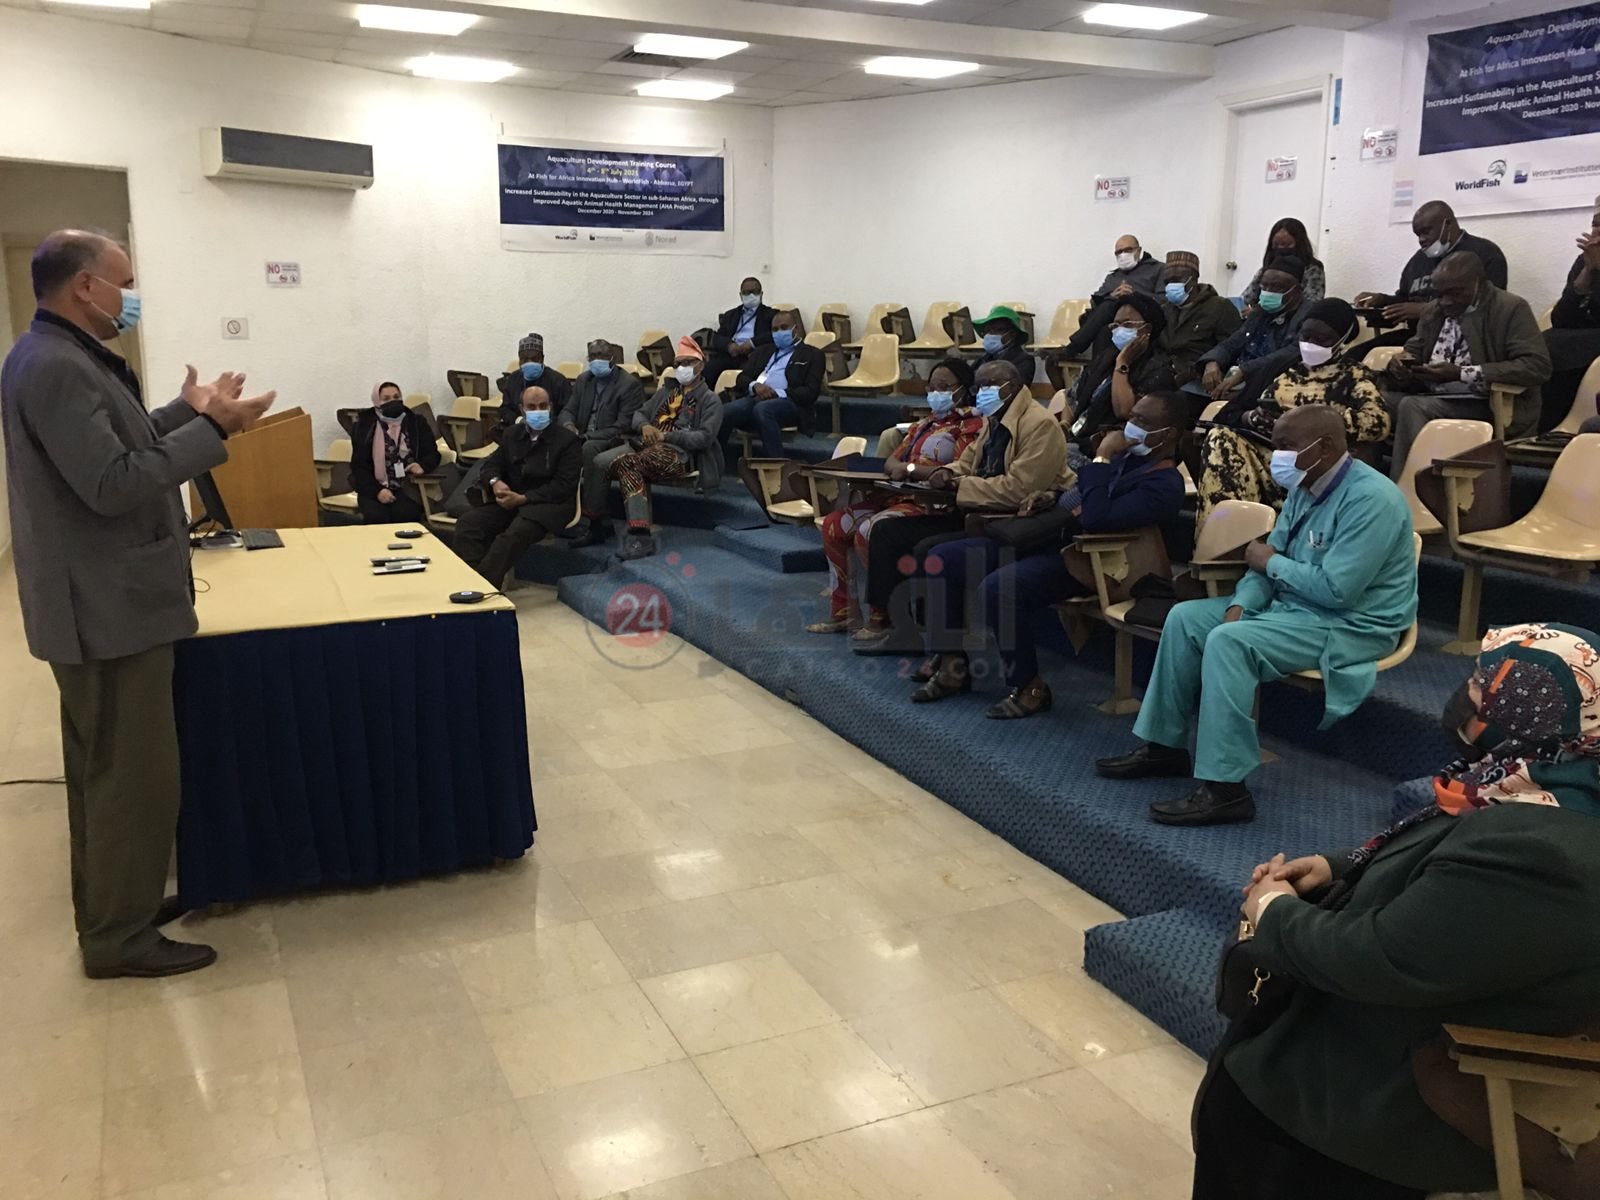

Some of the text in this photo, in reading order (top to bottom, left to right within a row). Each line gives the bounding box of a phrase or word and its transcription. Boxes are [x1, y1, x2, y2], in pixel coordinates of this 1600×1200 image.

[1485, 17, 1600, 45] Aquaculture Developm
[1459, 68, 1468, 79] At
[1469, 66, 1484, 76] Fish
[1485, 64, 1496, 73] for
[1496, 60, 1519, 71] Africa
[1521, 50, 1565, 66] Innovation
[1567, 46, 1586, 57] Hub
[1425, 95, 1463, 108] Increased
[1464, 86, 1515, 103] Sustainability
[1516, 84, 1524, 93] in
[1525, 83, 1539, 92] the
[1540, 74, 1594, 90] Aquaculture
[1461, 100, 1499, 116] Improved
[1499, 97, 1532, 110] Aquatic
[1533, 91, 1561, 104] Animal
[1563, 86, 1593, 100] Health
[1522, 107, 1559, 119] December
[1560, 102, 1579, 113] 2020
[1362, 136, 1376, 149] NO
[547, 154, 676, 169] Aquaculture Development Training Course
[610, 168, 622, 176] July
[1097, 180, 1110, 191] NO
[1455, 178, 1501, 191] WorldFish
[533, 189, 571, 197] Sustainability
[579, 190, 589, 198] the
[590, 191, 623, 200] Aquaculture
[648, 194, 680, 202] sub-Saharan
[267, 263, 280, 274] NO
